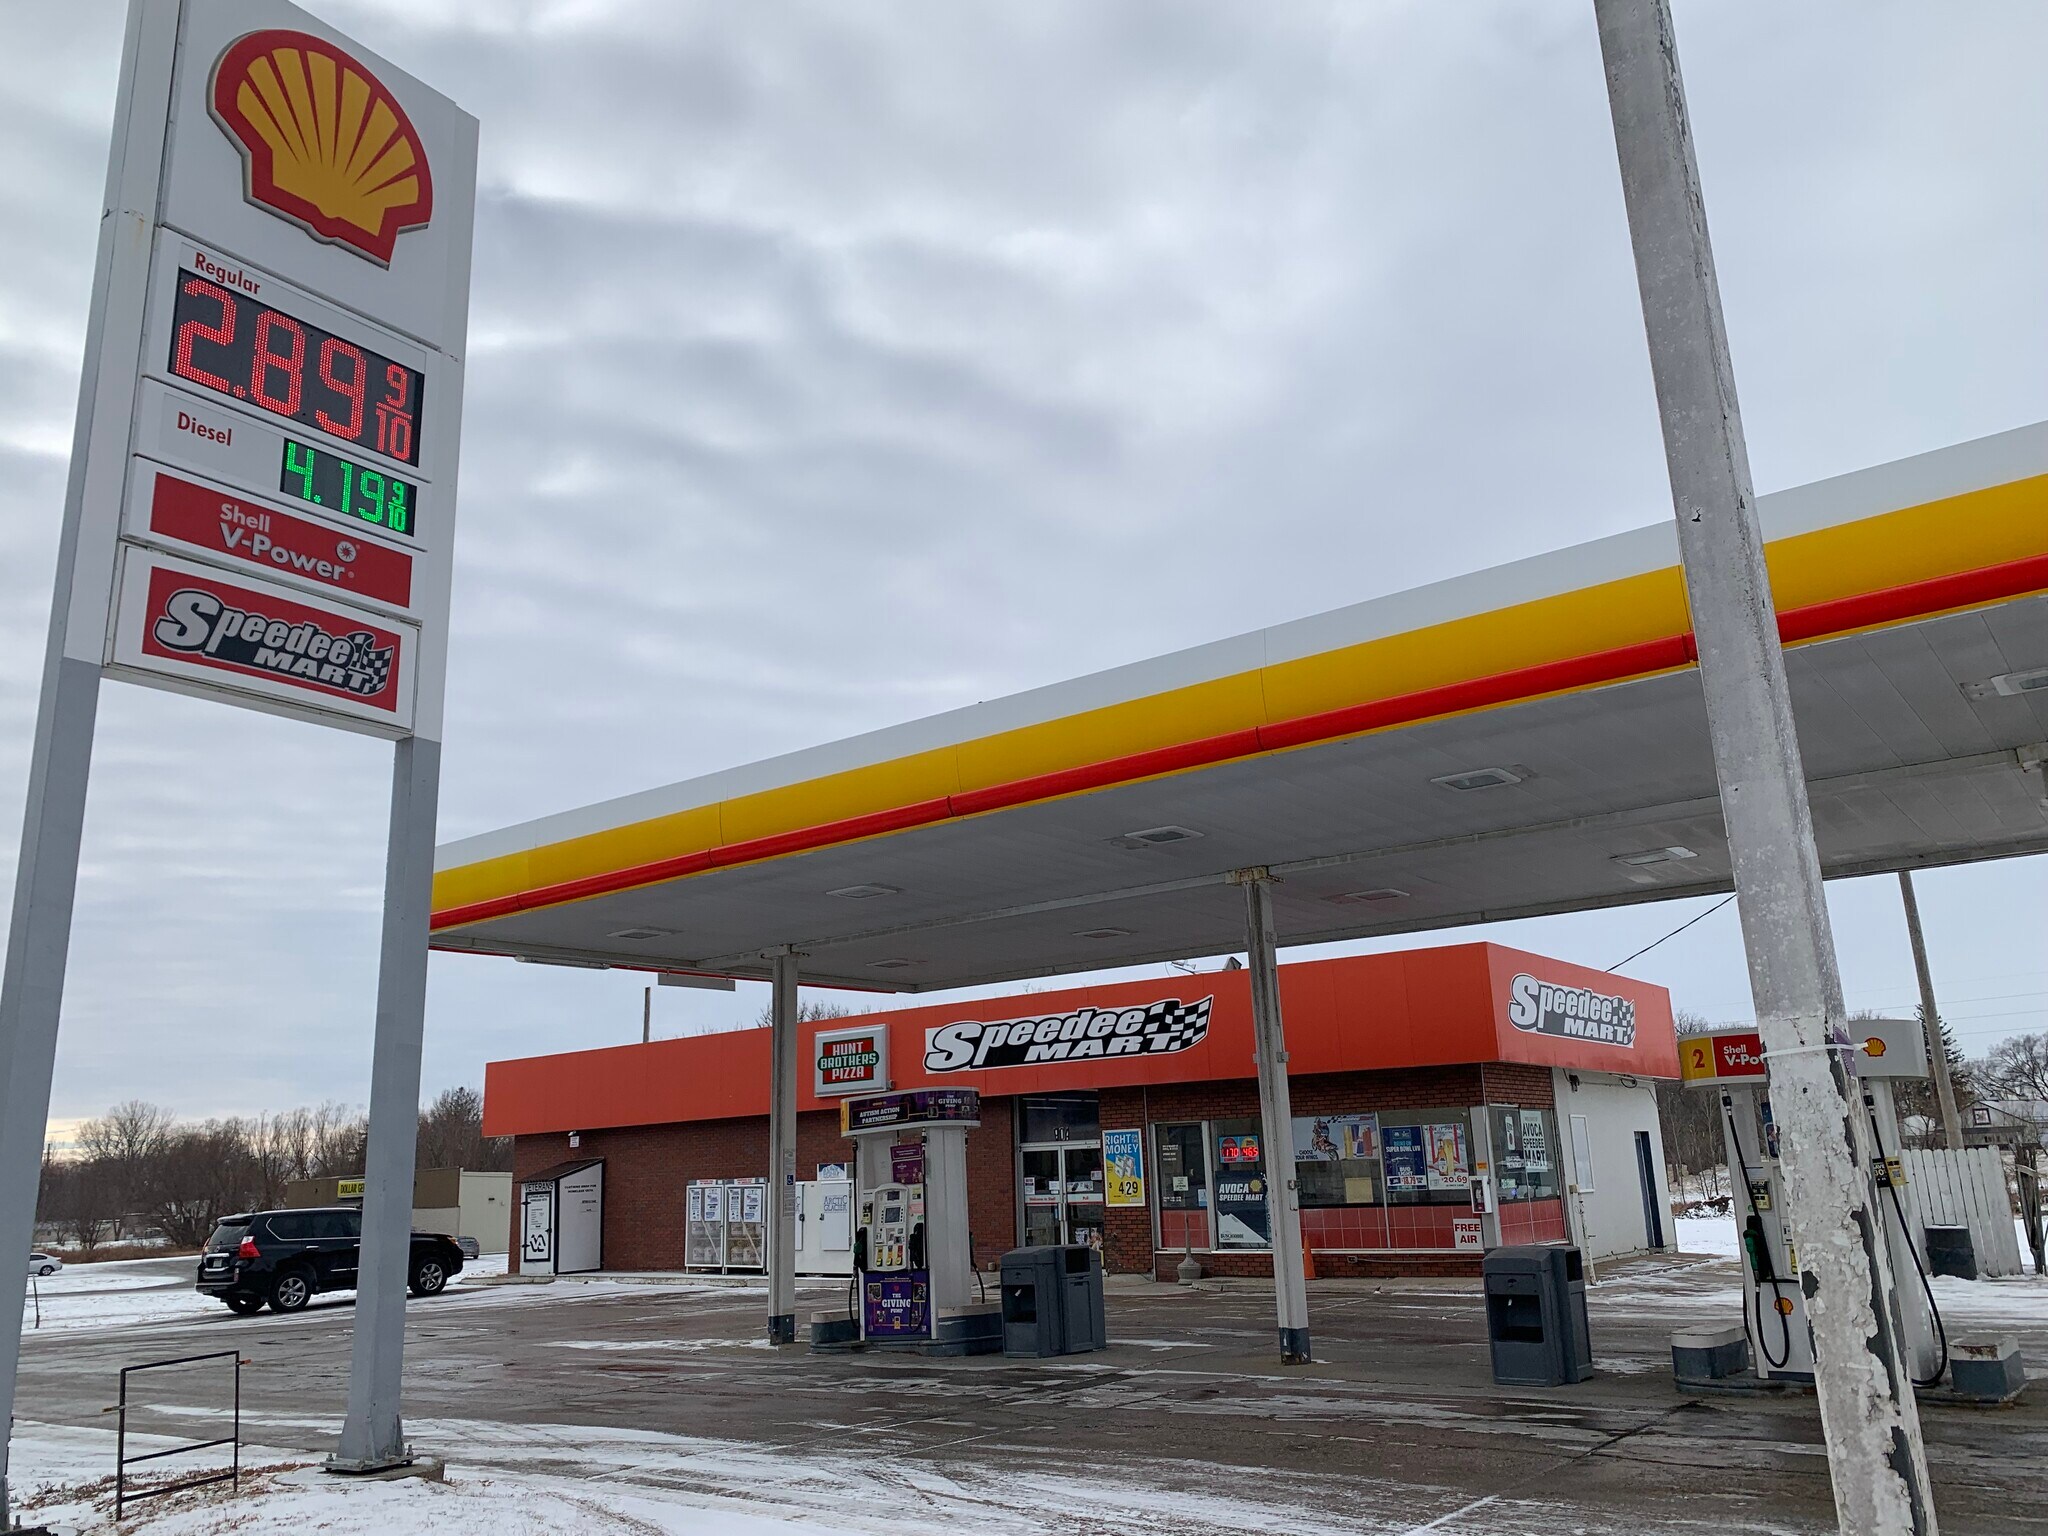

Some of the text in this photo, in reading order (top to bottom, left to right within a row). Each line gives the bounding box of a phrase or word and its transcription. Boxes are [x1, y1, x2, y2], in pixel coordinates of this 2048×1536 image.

[195, 252, 260, 294] Regular
[176, 279, 366, 440] 2.89
[385, 364, 408, 408] 9
[177, 411, 232, 446] Diesel
[286, 441, 385, 524] 4.19
[220, 503, 270, 533] Shell
[219, 522, 345, 581] V-Power
[154, 590, 352, 665] Speedee
[252, 647, 374, 689] MART
[1510, 975, 1612, 1028] Speedee
[1563, 1017, 1626, 1042] MART
[925, 1008, 1147, 1070] Speedee
[1024, 1032, 1182, 1062] MART
[832, 1042, 863, 1056] HUNT
[1724, 1044, 1747, 1054] Shell
[820, 1053, 877, 1069] BROTHERS
[1692, 1048, 1705, 1068] 2
[832, 1066, 864, 1080] PIZZA
[860, 1106, 900, 1118] AUTISM ACTION
[862, 1114, 898, 1124] PARTNERSHIP
[1522, 1123, 1543, 1137] AVOCA
[1105, 1134, 1131, 1144] RIGHT
[1523, 1138, 1545, 1148] SPEEDEE
[1105, 1144, 1139, 1155] MONEY
[1524, 1150, 1547, 1167] MART
[525, 1182, 553, 1192] VETERANS
[1219, 1183, 1250, 1193] AVOCA
[824, 1195, 848, 1204] ARCTIC
[1455, 1223, 1480, 1232] FREE
[1460, 1235, 1477, 1243] AIR
[881, 1299, 911, 1307] GIVING
